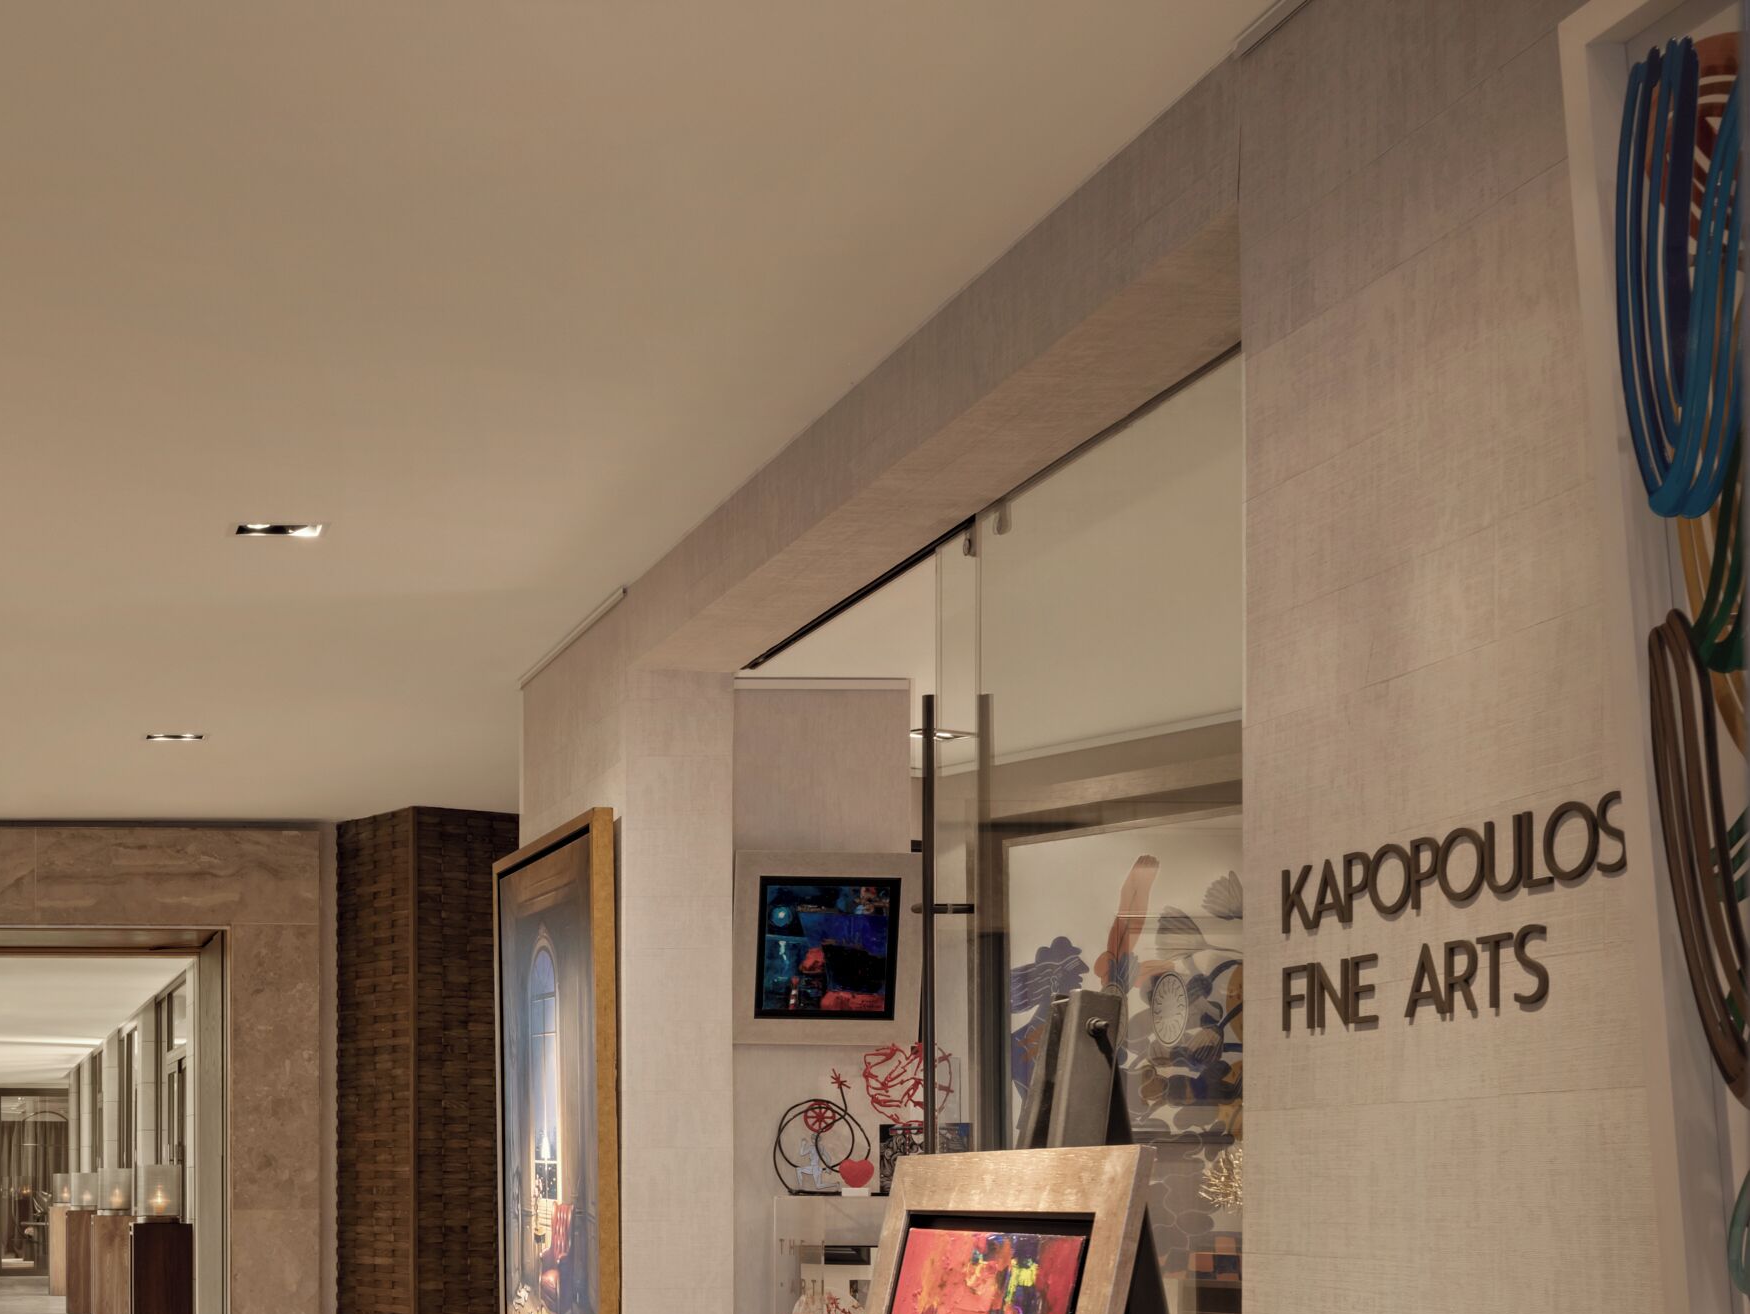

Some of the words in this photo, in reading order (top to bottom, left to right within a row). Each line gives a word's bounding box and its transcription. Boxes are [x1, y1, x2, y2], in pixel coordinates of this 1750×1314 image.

[1281, 790, 1627, 934] KAPOPOULOS
[1281, 953, 1378, 1032] FINE
[1404, 924, 1550, 1019] ARTS
